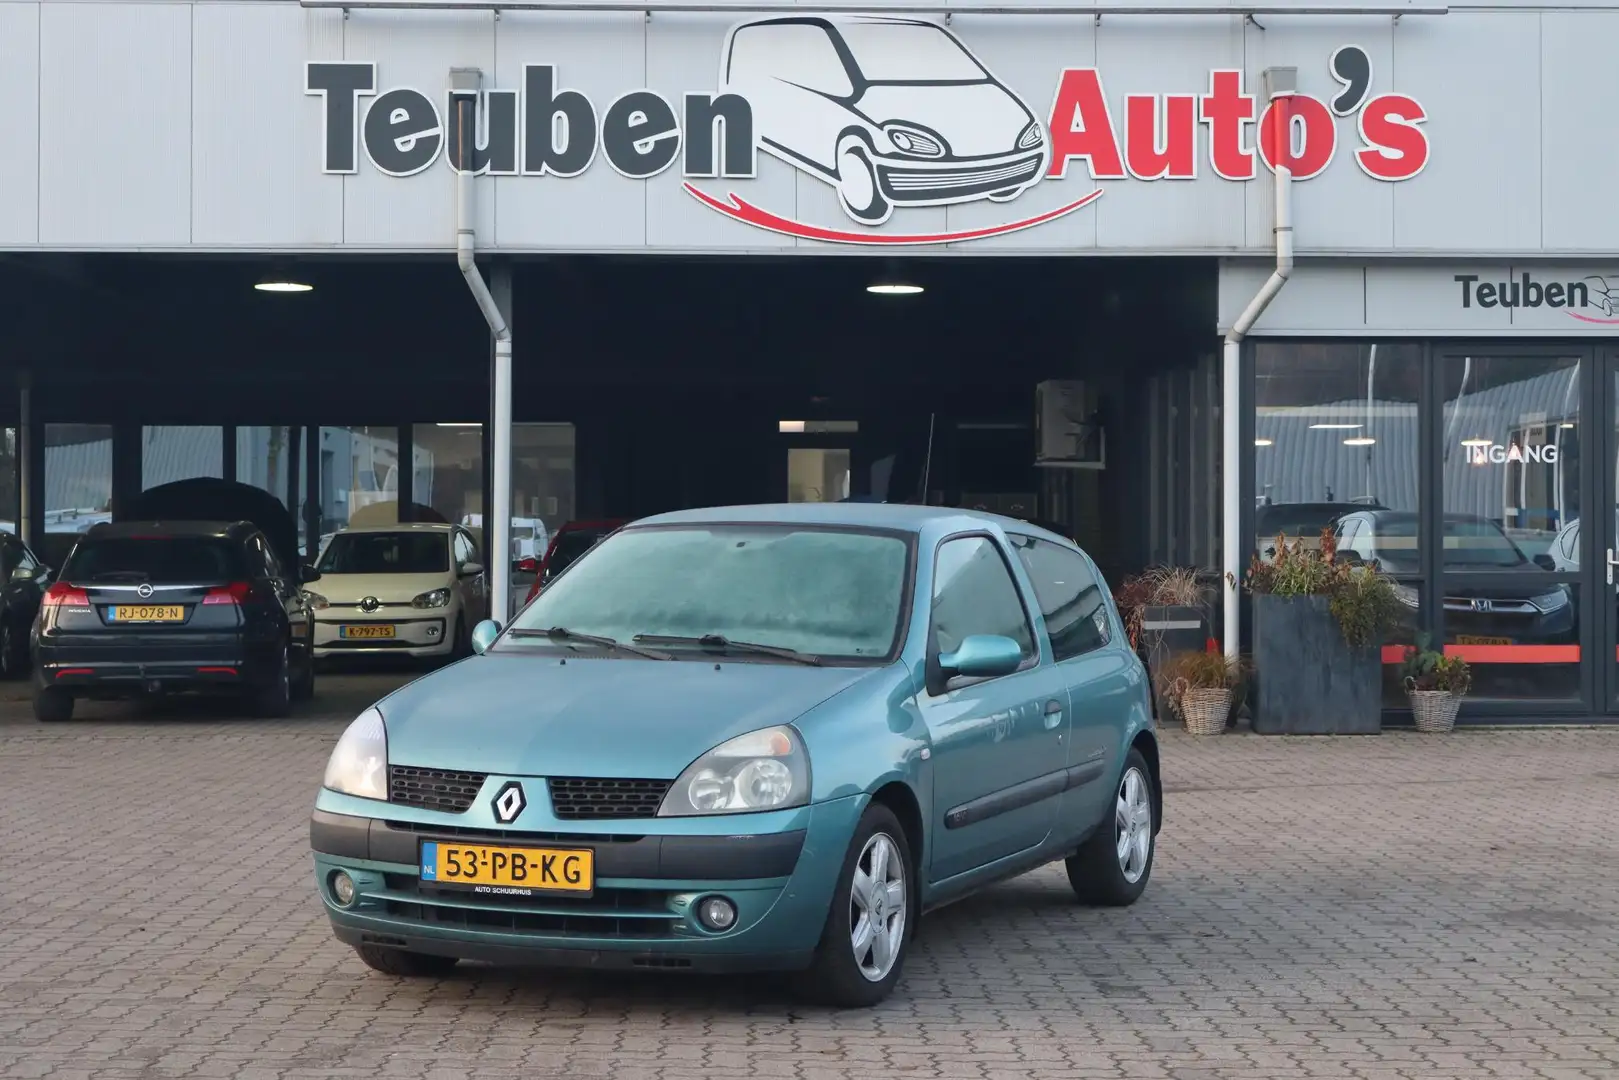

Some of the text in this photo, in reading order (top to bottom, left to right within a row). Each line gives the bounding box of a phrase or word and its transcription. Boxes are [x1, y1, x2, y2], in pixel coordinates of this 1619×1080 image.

[305, 44, 1430, 181] Teuben Auto's
[1454, 272, 1589, 308] Teuben
[1466, 444, 1558, 464] INGANG
[119, 607, 178, 619] RJ-078-N
[349, 627, 391, 637] K-797-TS
[423, 865, 435, 875] NL
[475, 886, 491, 894] AUTO
